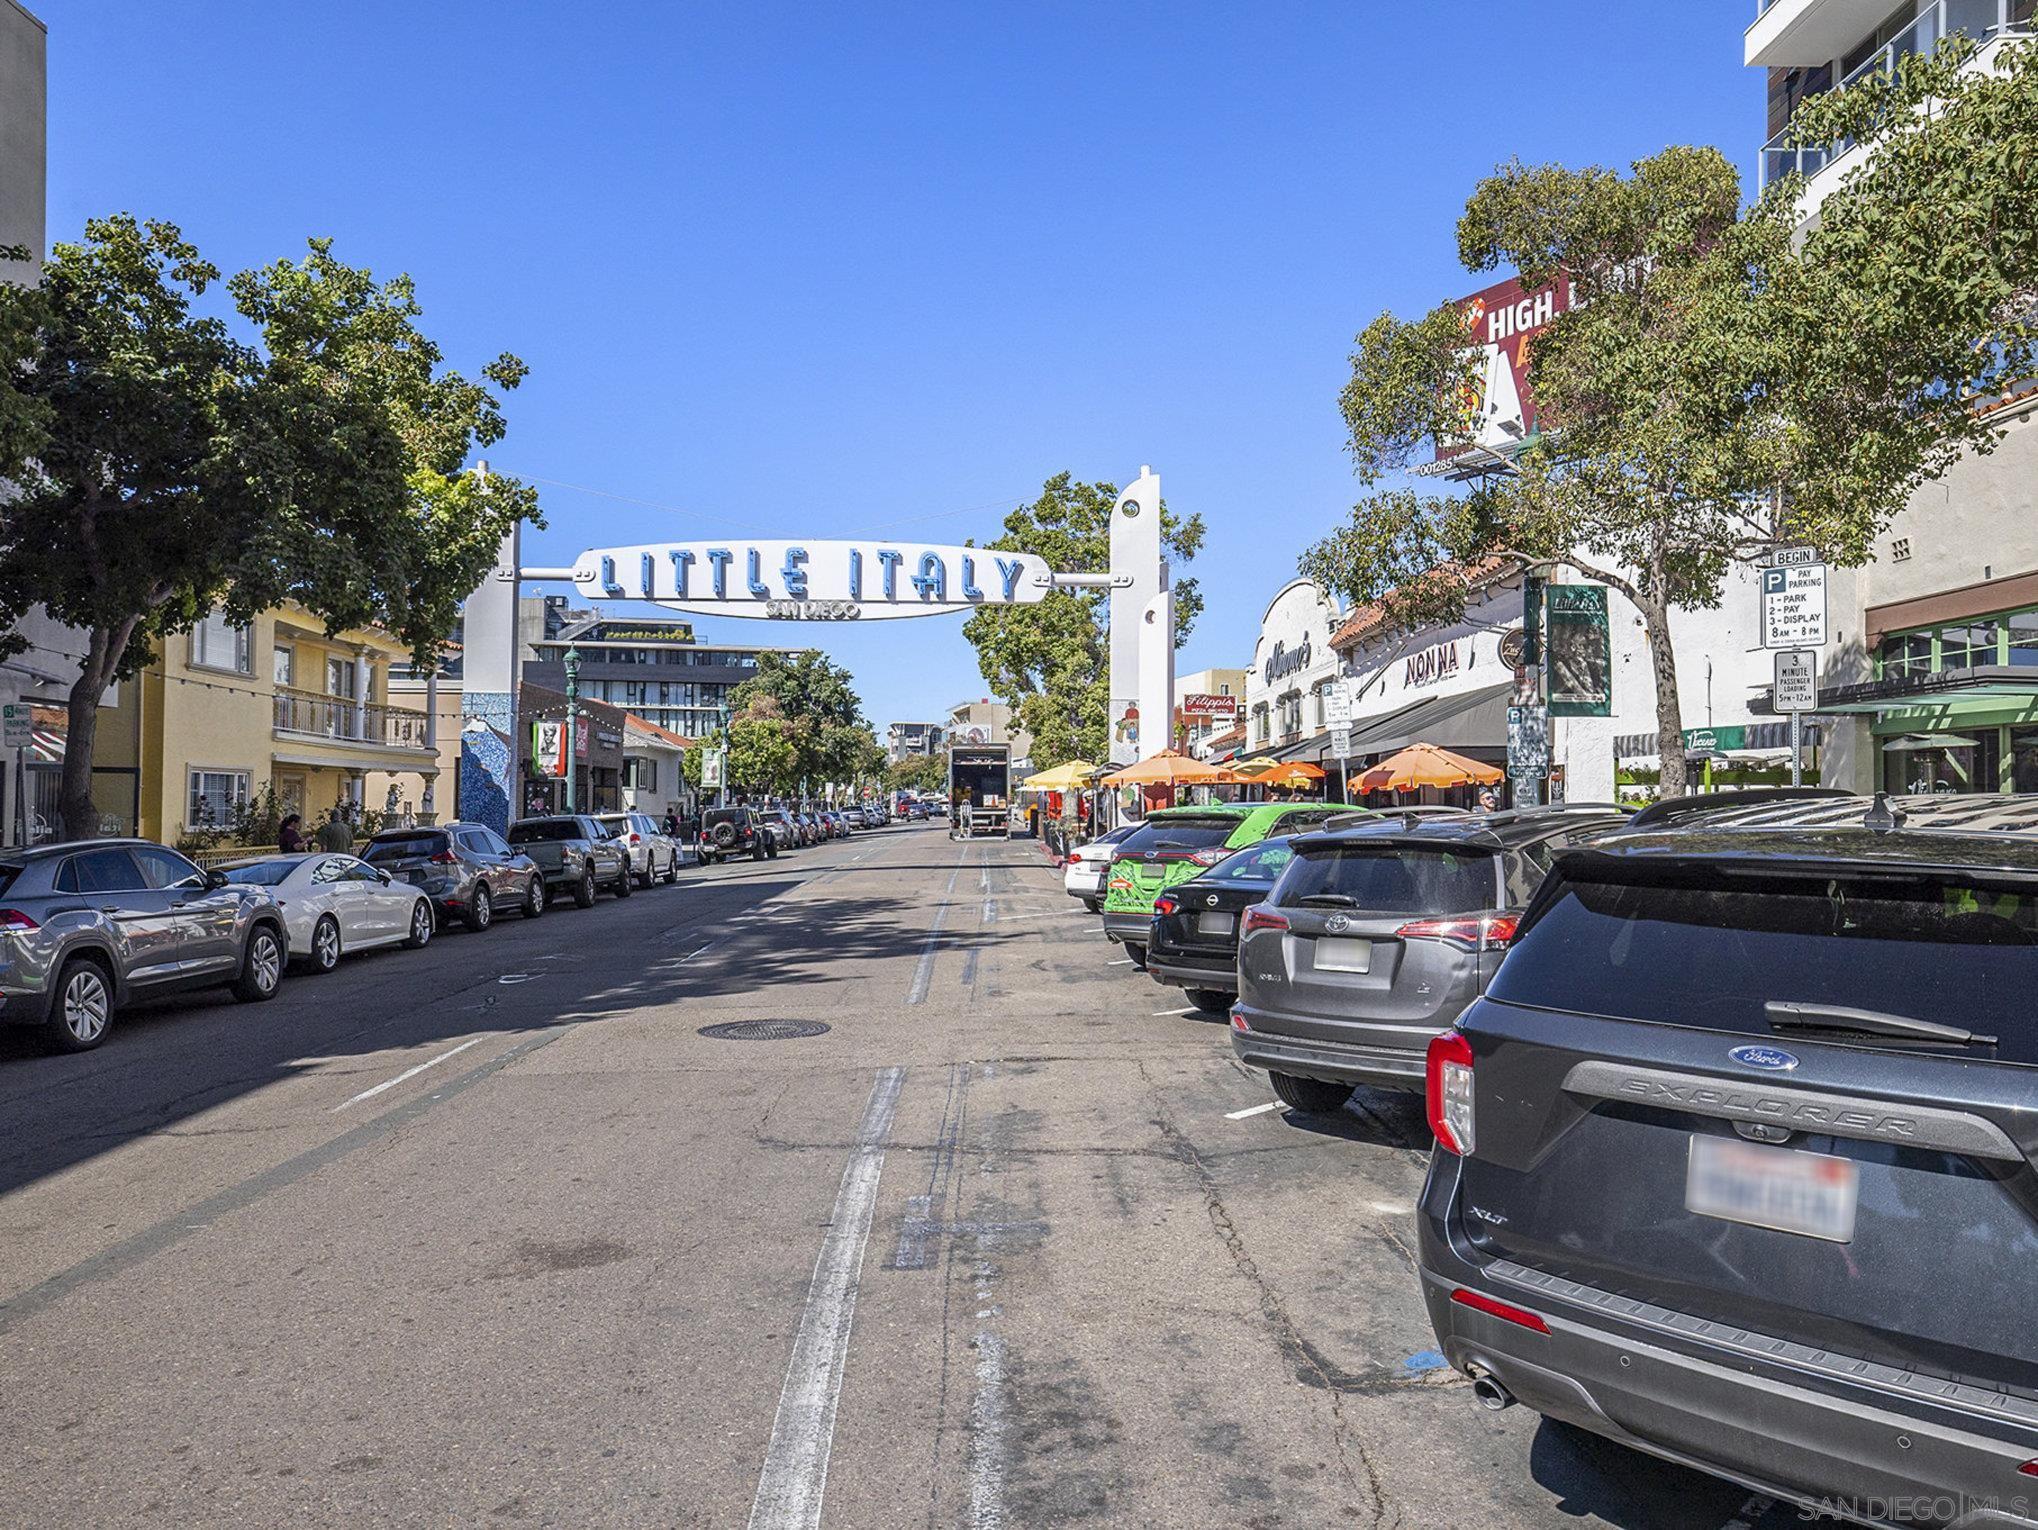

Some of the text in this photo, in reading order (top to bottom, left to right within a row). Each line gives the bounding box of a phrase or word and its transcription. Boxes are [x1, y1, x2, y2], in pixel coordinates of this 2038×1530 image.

[1777, 550, 1811, 564] BEGIN
[601, 547, 1020, 596] LITTLE ITALY
[1797, 569, 1812, 578] PAY
[1768, 573, 1783, 591] P
[1788, 578, 1822, 588] PARKING
[1783, 593, 1807, 603] PARK
[766, 600, 862, 619] SAN DIEGO
[1769, 606, 1776, 615] 2
[1783, 605, 1800, 614] PAY
[1769, 617, 1776, 625] 3
[1783, 613, 1822, 624] DISPLAY
[1405, 642, 1458, 684] NONNA
[1792, 655, 1798, 666] 3
[1782, 667, 1808, 677] MINUTE
[1186, 695, 1234, 709] Filippi's
[1744, 1048, 1782, 1065] Ford
[1619, 1078, 1918, 1136] EXPLORER
[1468, 1205, 1508, 1225] XLT
